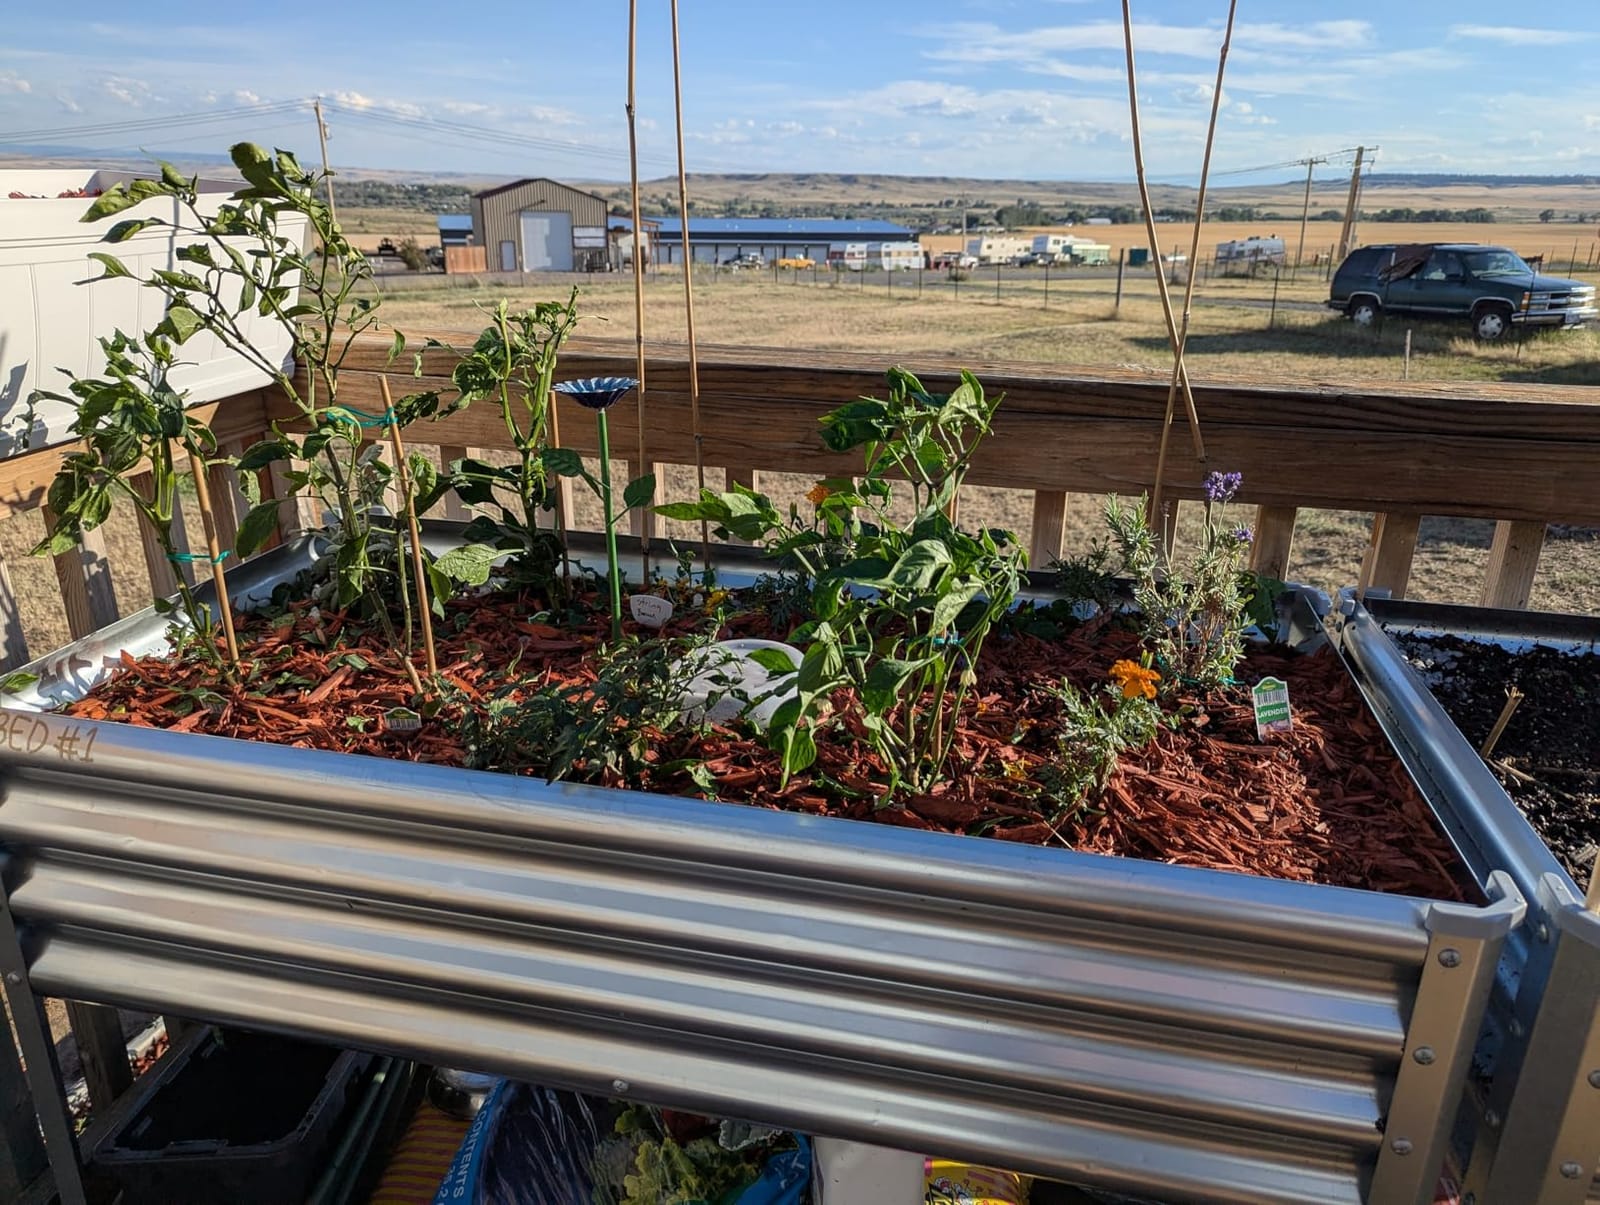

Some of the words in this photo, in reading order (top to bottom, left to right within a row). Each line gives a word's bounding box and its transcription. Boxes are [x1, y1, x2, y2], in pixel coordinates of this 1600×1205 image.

[0, 711, 49, 754] BED
[53, 725, 98, 762] #1
[1257, 707, 1288, 718] LAVENDER
[453, 1110, 487, 1198] CONTENTS
